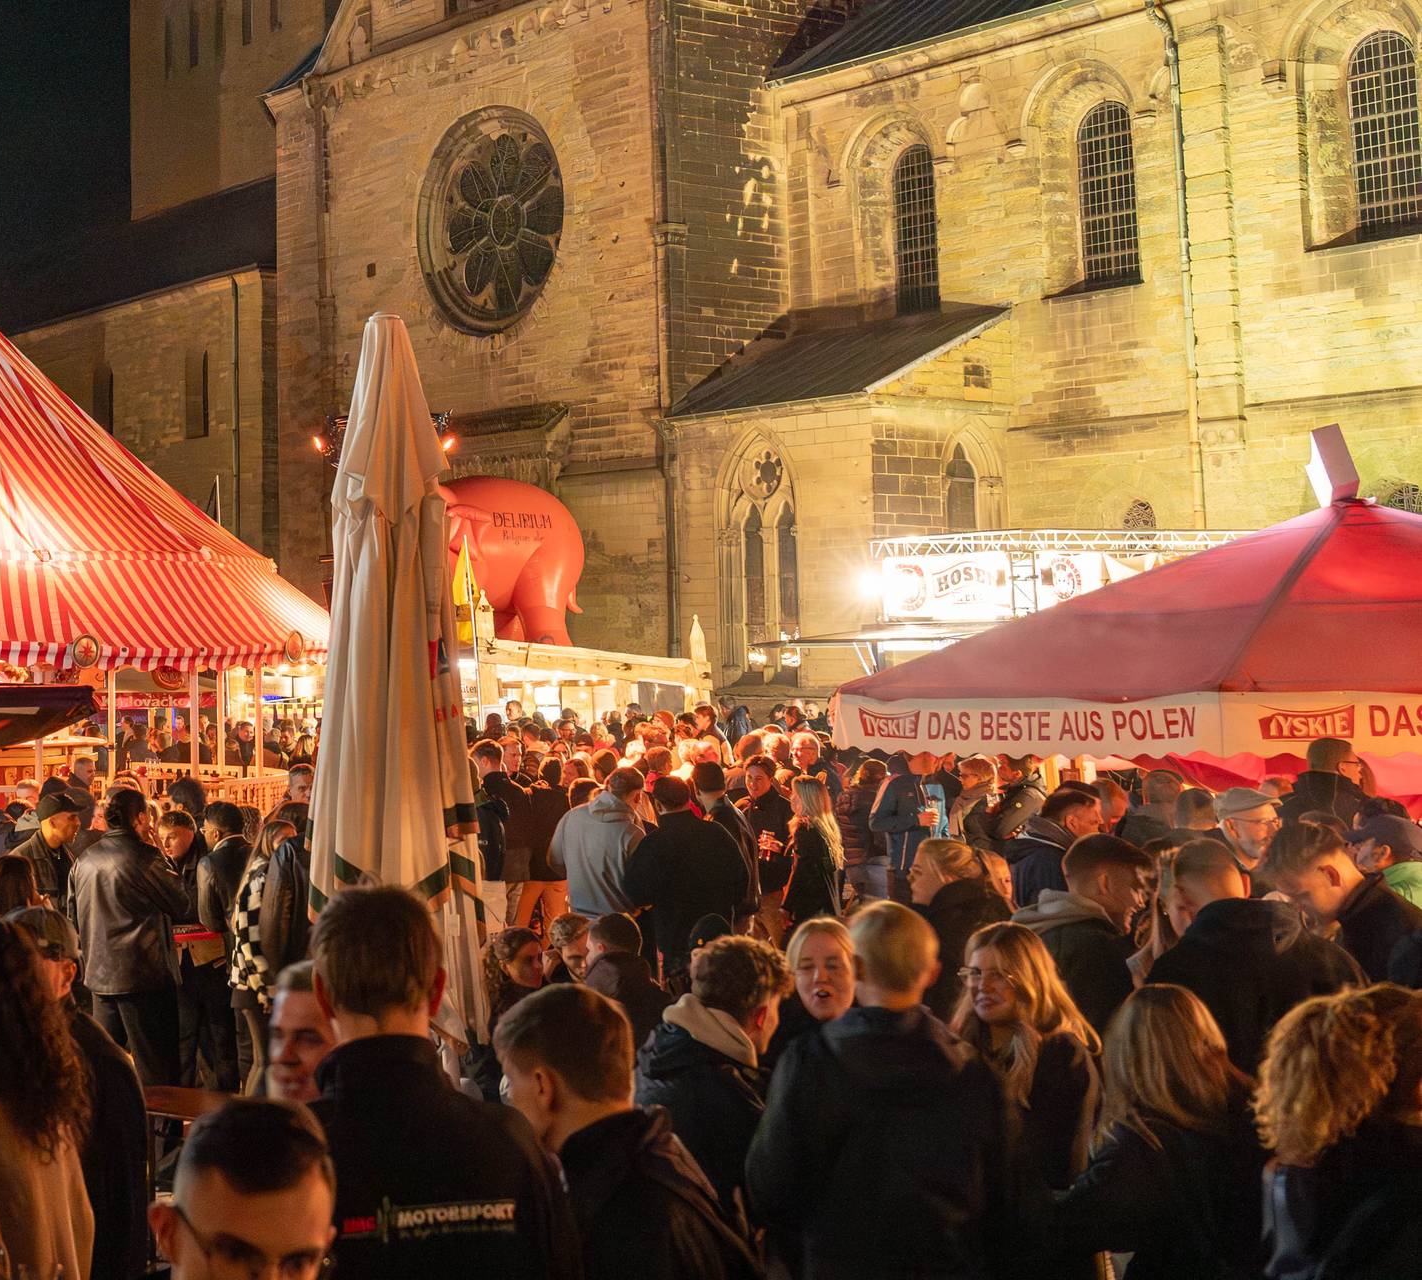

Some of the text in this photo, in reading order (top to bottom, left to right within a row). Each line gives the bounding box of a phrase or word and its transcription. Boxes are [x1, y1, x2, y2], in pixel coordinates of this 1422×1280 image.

[492, 511, 553, 529] DELIRIUM
[101, 692, 189, 708] Klovačko
[862, 706, 1196, 742] TYSKIE DAS BESTE AUS POLEN
[1267, 711, 1352, 738] TYSKIE
[396, 1203, 516, 1229] MOTORSPORT
